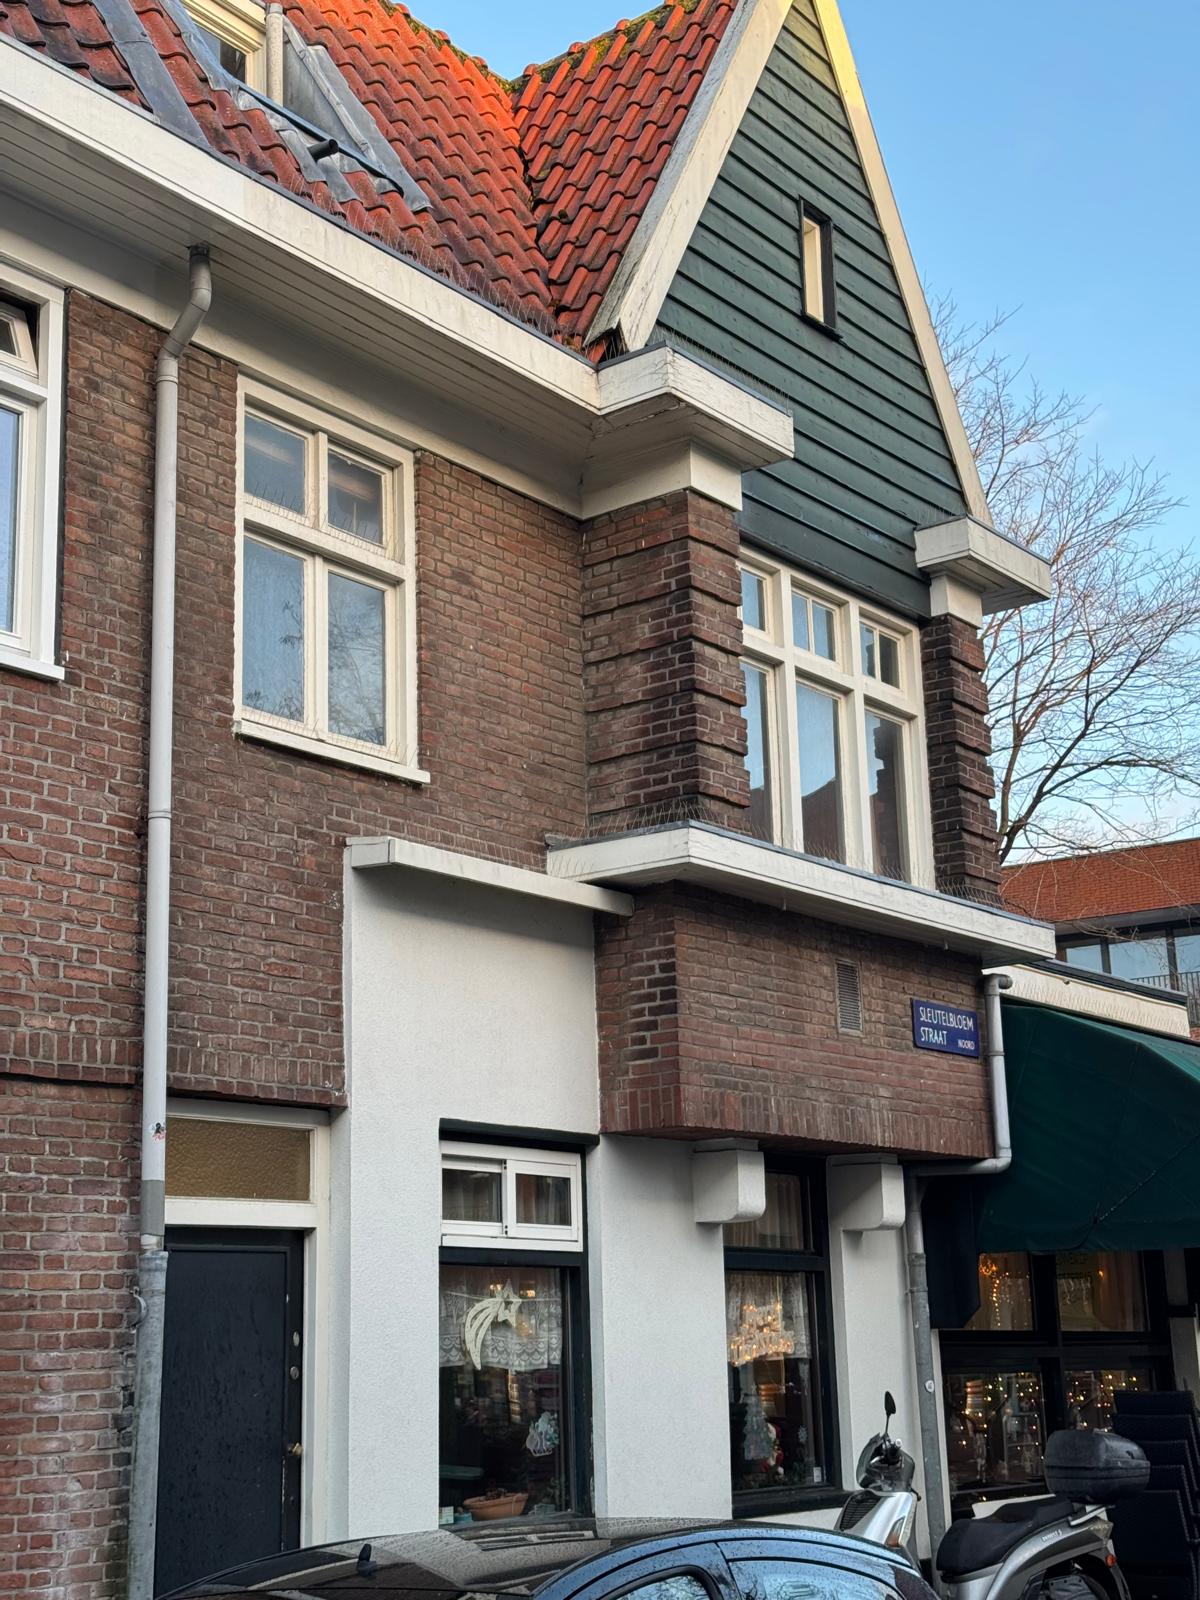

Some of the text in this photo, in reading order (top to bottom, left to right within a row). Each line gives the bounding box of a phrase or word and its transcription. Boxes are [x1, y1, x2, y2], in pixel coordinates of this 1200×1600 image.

[919, 1006, 974, 1031] SLEUTELBLOEM
[920, 1026, 947, 1045] STRAAT
[957, 1039, 975, 1050] NOORD
